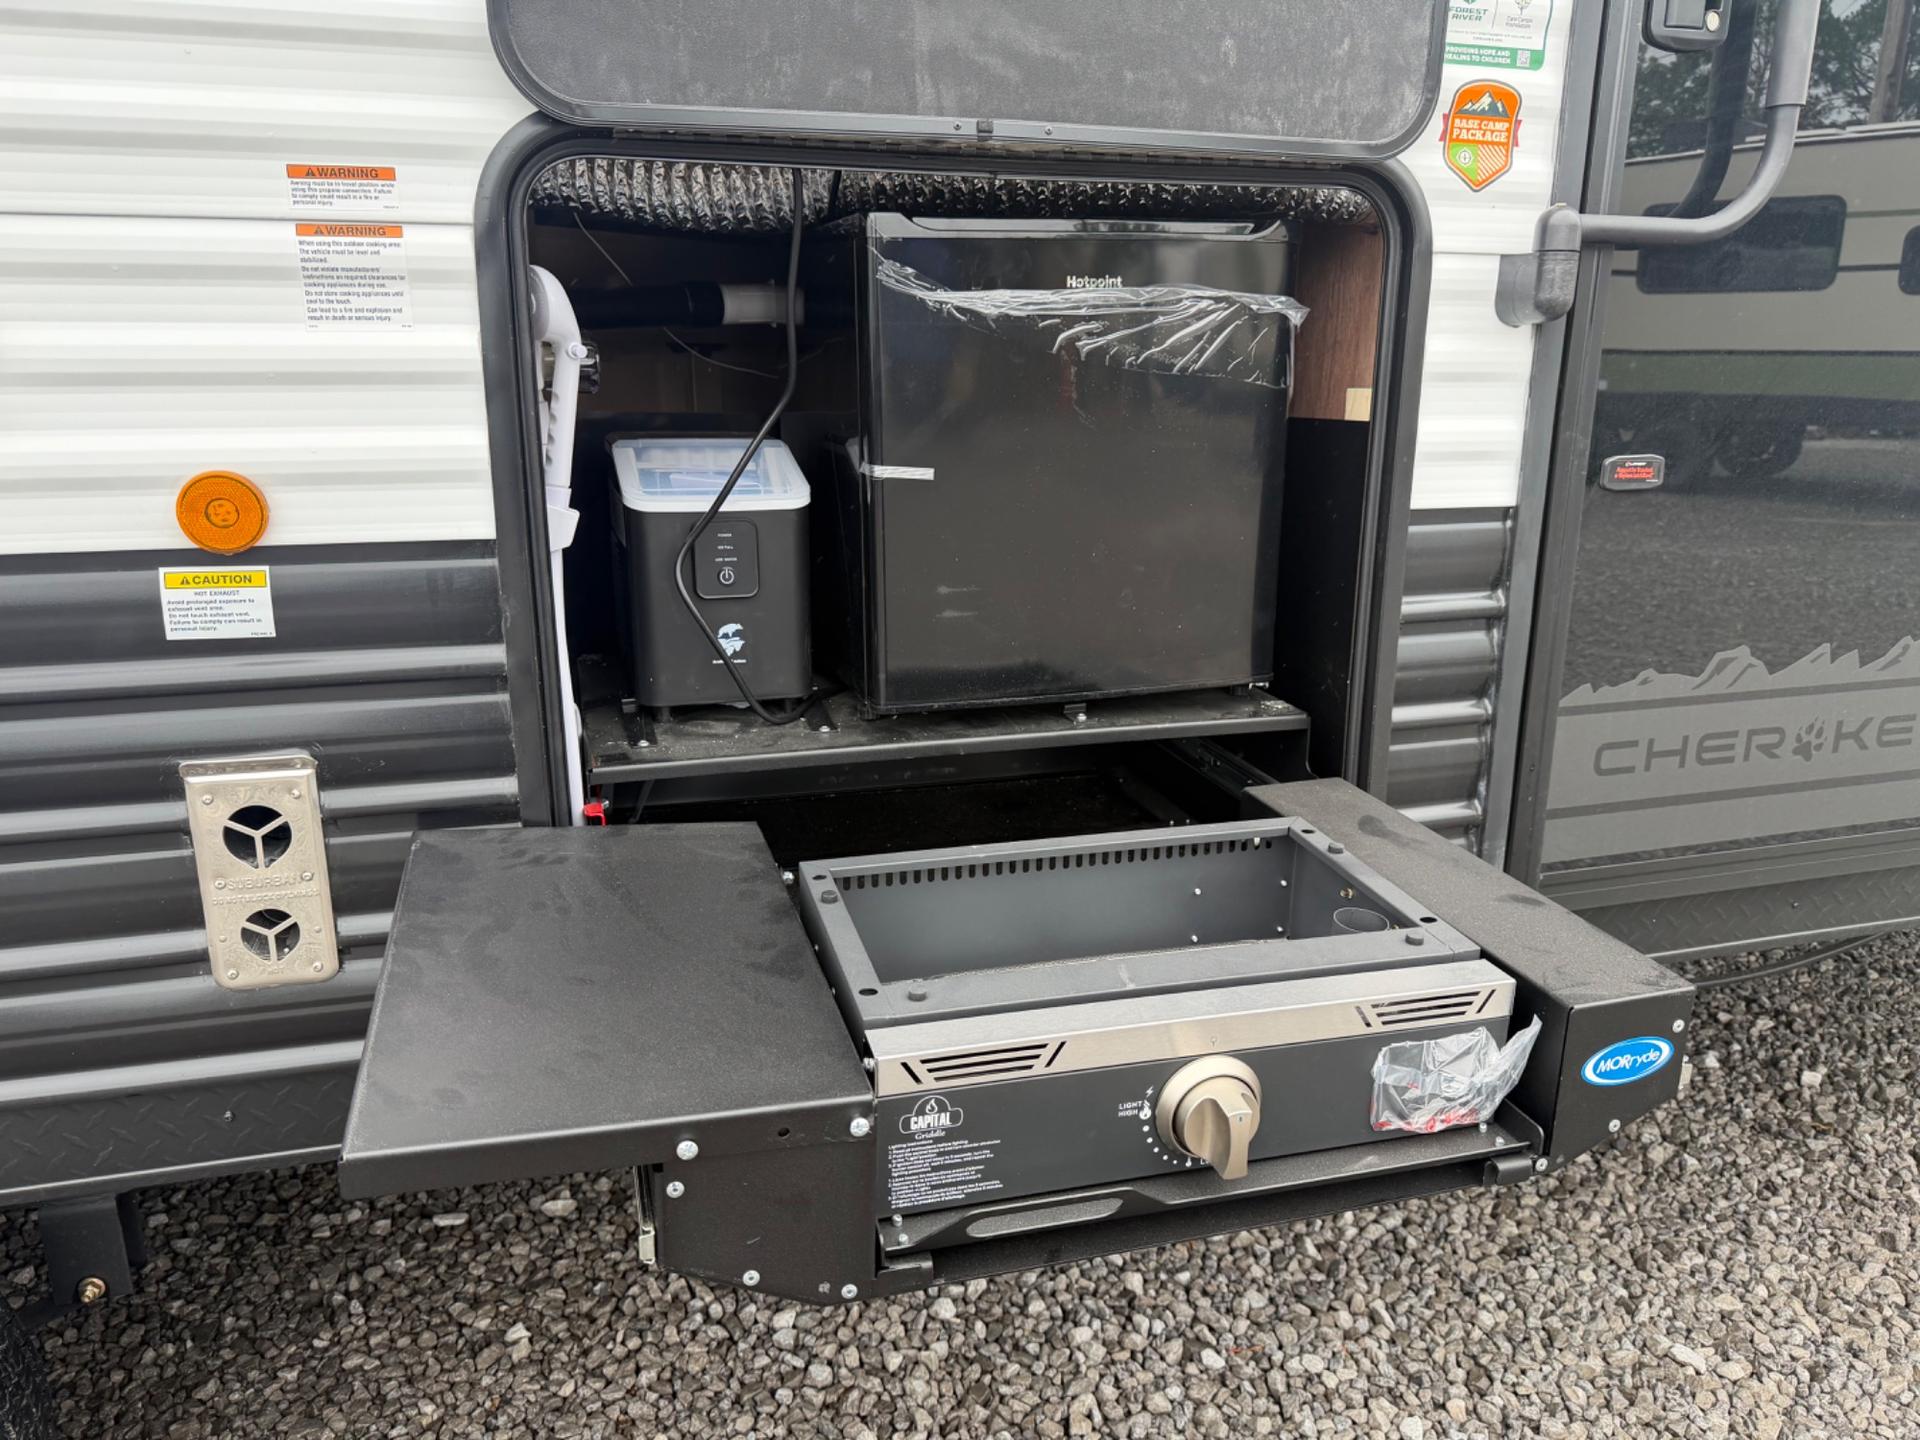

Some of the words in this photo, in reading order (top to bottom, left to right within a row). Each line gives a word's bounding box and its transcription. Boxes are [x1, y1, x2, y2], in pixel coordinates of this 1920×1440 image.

[1452, 13, 1482, 21] RIVER
[1479, 48, 1496, 56] HOPE
[1471, 54, 1480, 62] TO
[1481, 55, 1511, 64] CHILDREN
[1453, 118, 1480, 128] BASE
[1481, 120, 1510, 131] CAMP
[1452, 128, 1509, 143] PACKAGE
[317, 167, 379, 179] WARNING
[325, 224, 387, 236] WARNING
[1066, 274, 1122, 290] Hotpoint
[192, 575, 252, 585] CAUTION
[209, 589, 240, 597] EXHAUST
[1596, 1048, 1660, 1074] MORryde
[1118, 1100, 1143, 1110] LIGHT
[1118, 1109, 1138, 1118] HIGH
[910, 1111, 952, 1131] CAPITAL
[915, 1129, 946, 1140] Griddle
